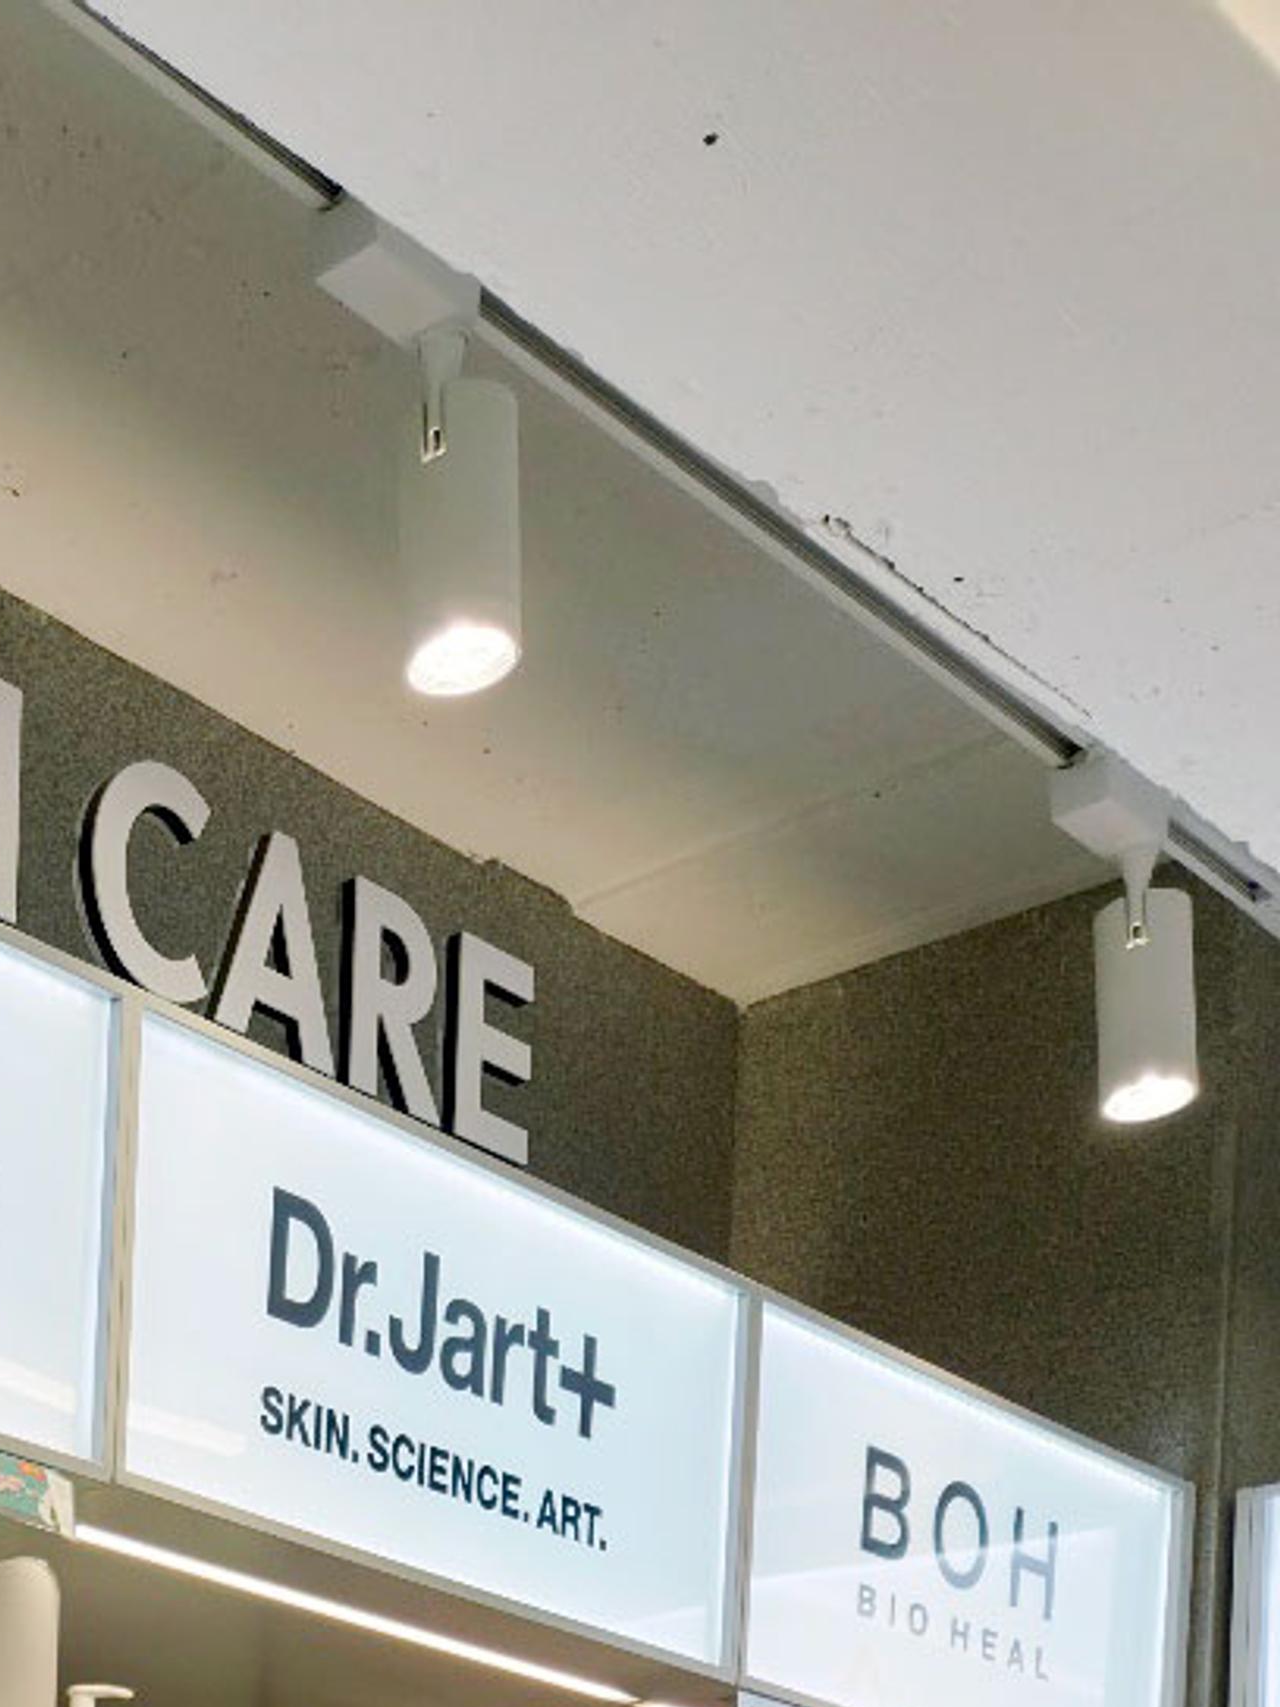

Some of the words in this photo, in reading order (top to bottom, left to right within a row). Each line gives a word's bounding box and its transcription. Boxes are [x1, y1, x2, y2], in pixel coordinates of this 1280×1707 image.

[75, 760, 536, 1167] CARE
[264, 1185, 617, 1440] Dr.Jart+
[259, 1385, 360, 1465] SKIN.
[365, 1425, 531, 1524] SCIENCE.
[535, 1496, 609, 1552] ART.
[859, 1444, 1059, 1622] BOH
[855, 1582, 929, 1638] BIO
[949, 1615, 1051, 1682] HEAL
